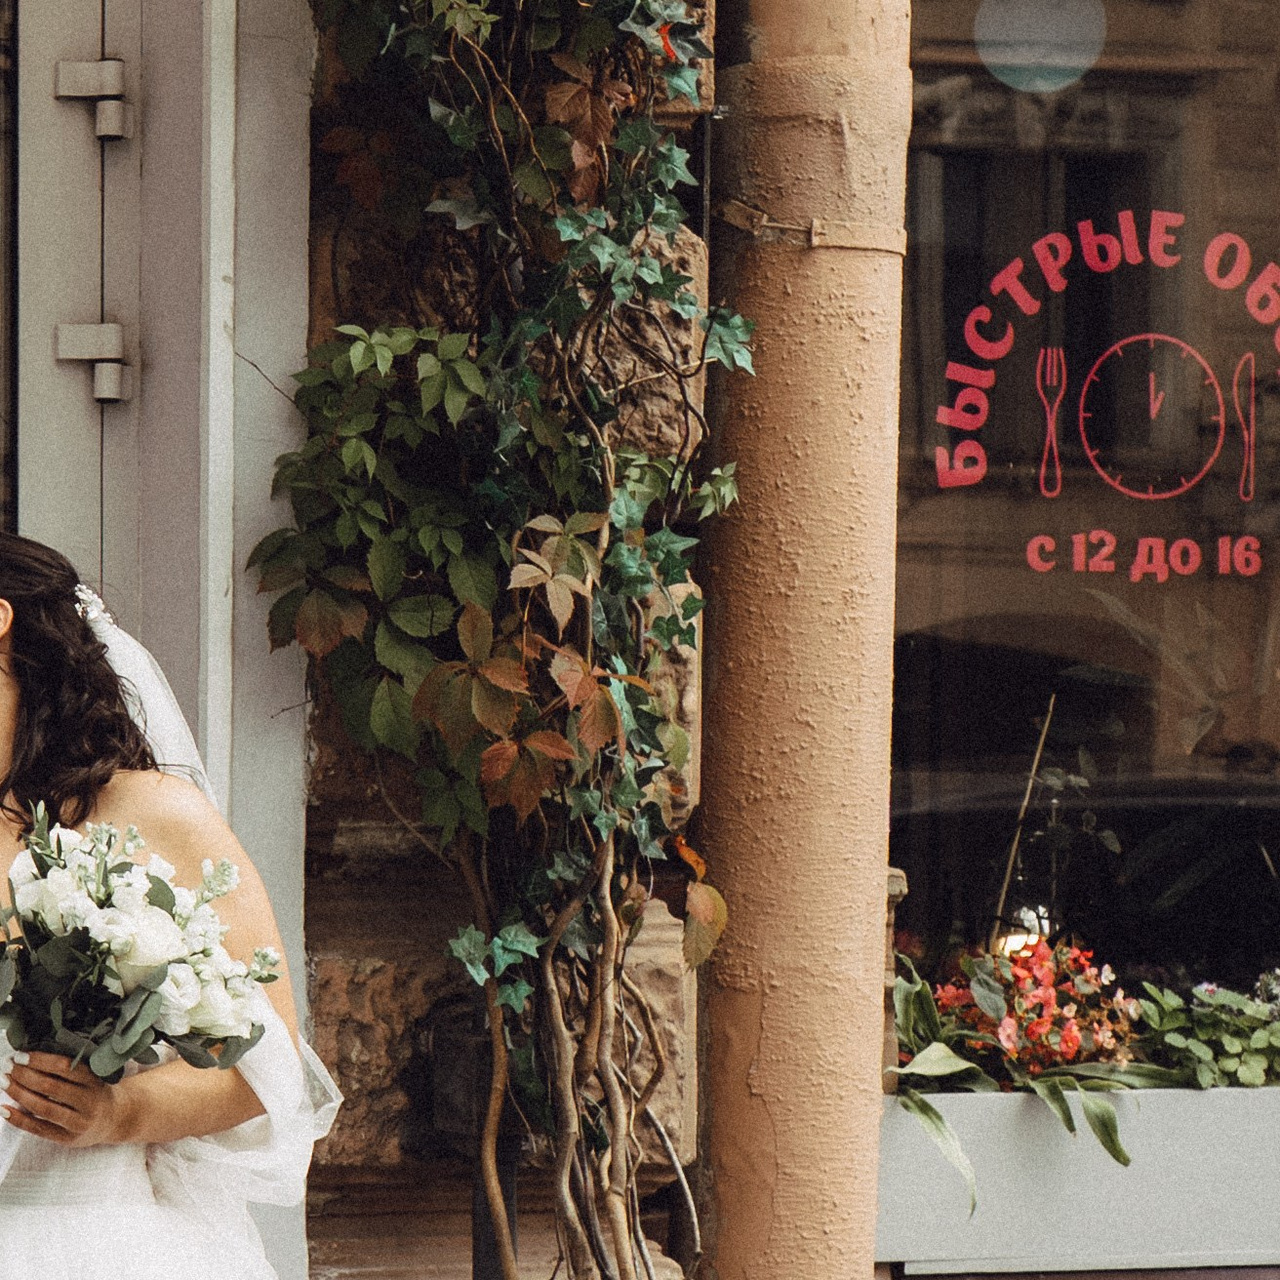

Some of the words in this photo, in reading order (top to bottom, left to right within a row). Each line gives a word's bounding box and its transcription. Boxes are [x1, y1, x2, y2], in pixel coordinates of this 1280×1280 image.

[935, 209, 1186, 489] БЫСТРЫЕ
[1203, 232, 1280, 354] ОБ
[1071, 528, 1117, 573] 12
[1218, 535, 1262, 576] 16
